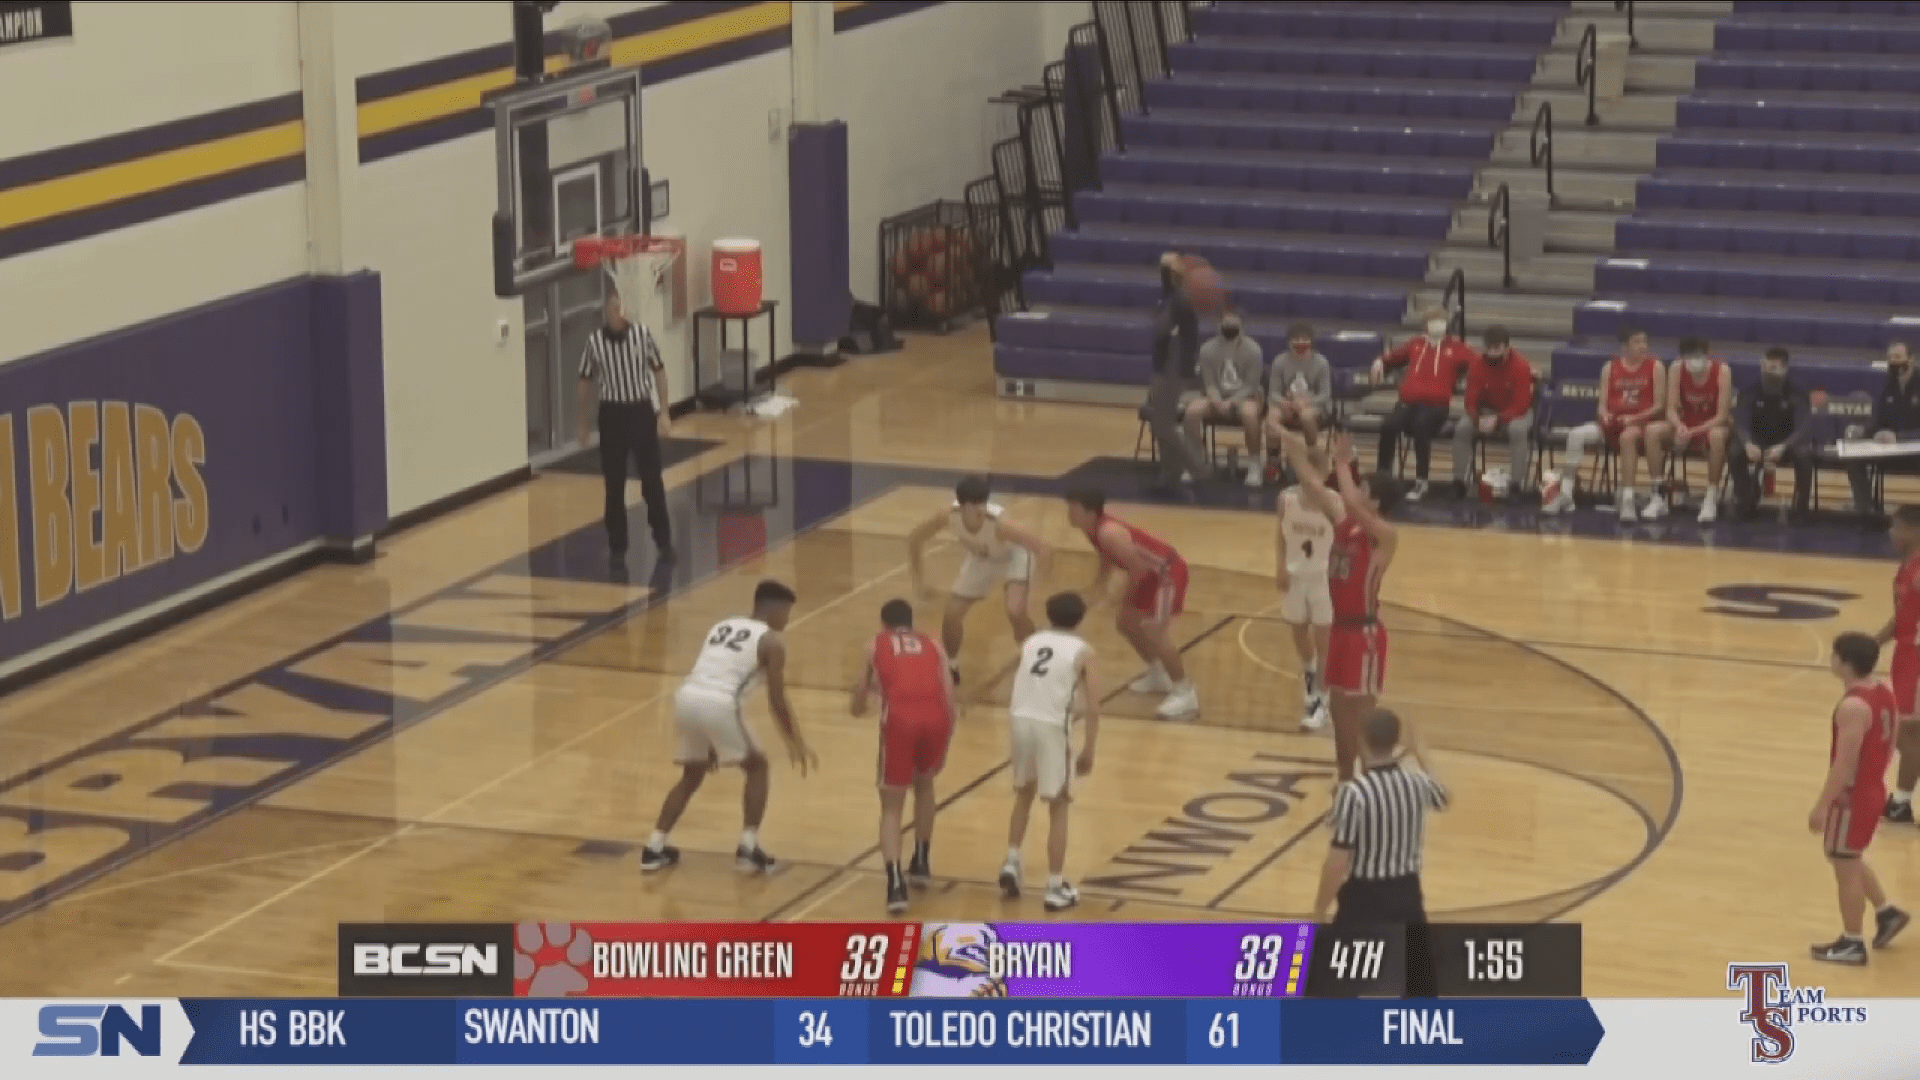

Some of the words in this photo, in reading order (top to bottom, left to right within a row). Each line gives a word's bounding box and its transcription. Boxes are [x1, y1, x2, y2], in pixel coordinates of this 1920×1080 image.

[27, 400, 209, 609] BEARS
[1301, 540, 1314, 559] 4
[709, 624, 751, 653] 32
[1030, 647, 1054, 677] 2
